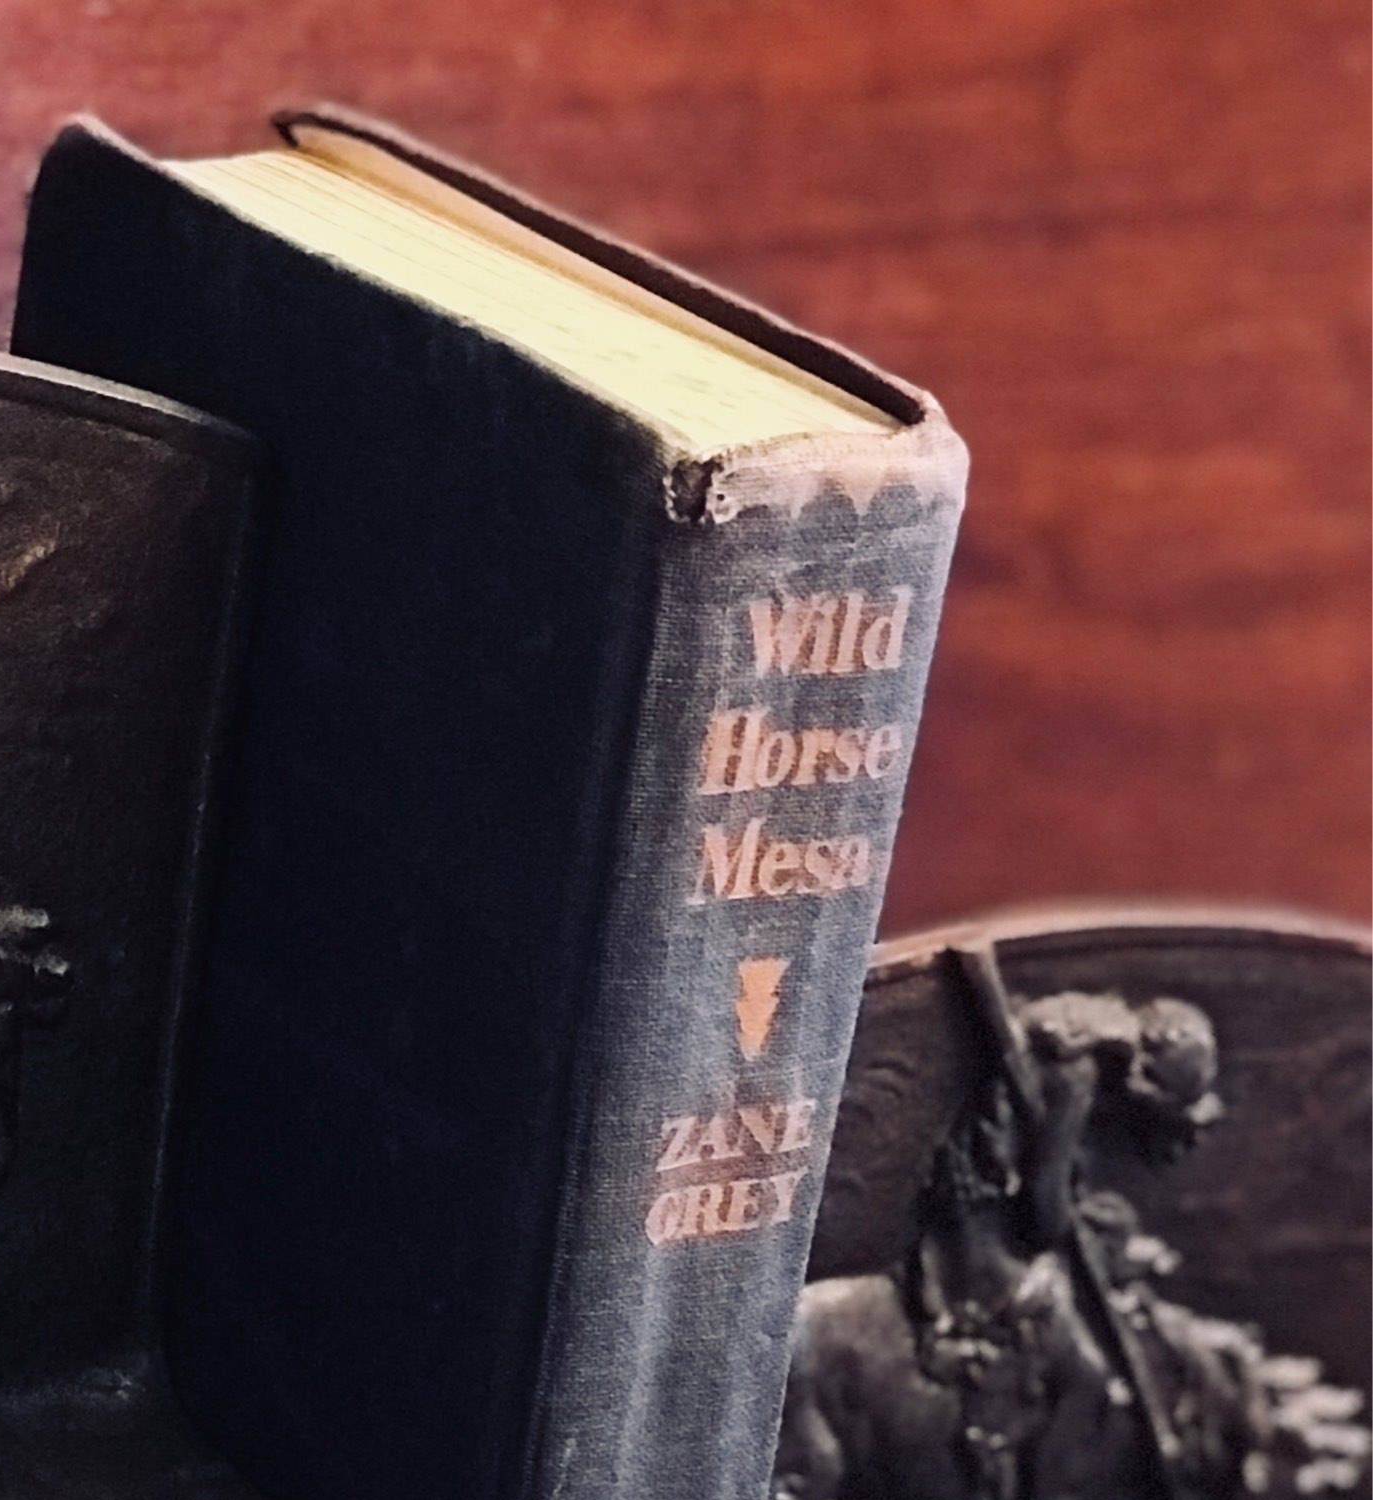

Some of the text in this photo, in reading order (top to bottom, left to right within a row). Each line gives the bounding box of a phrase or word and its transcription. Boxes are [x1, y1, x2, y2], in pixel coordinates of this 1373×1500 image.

[749, 586, 912, 677] Wild
[698, 705, 903, 795] Horse
[686, 822, 873, 906] Mesa
[657, 1098, 813, 1171] ZANE
[645, 1166, 808, 1246] GREY
